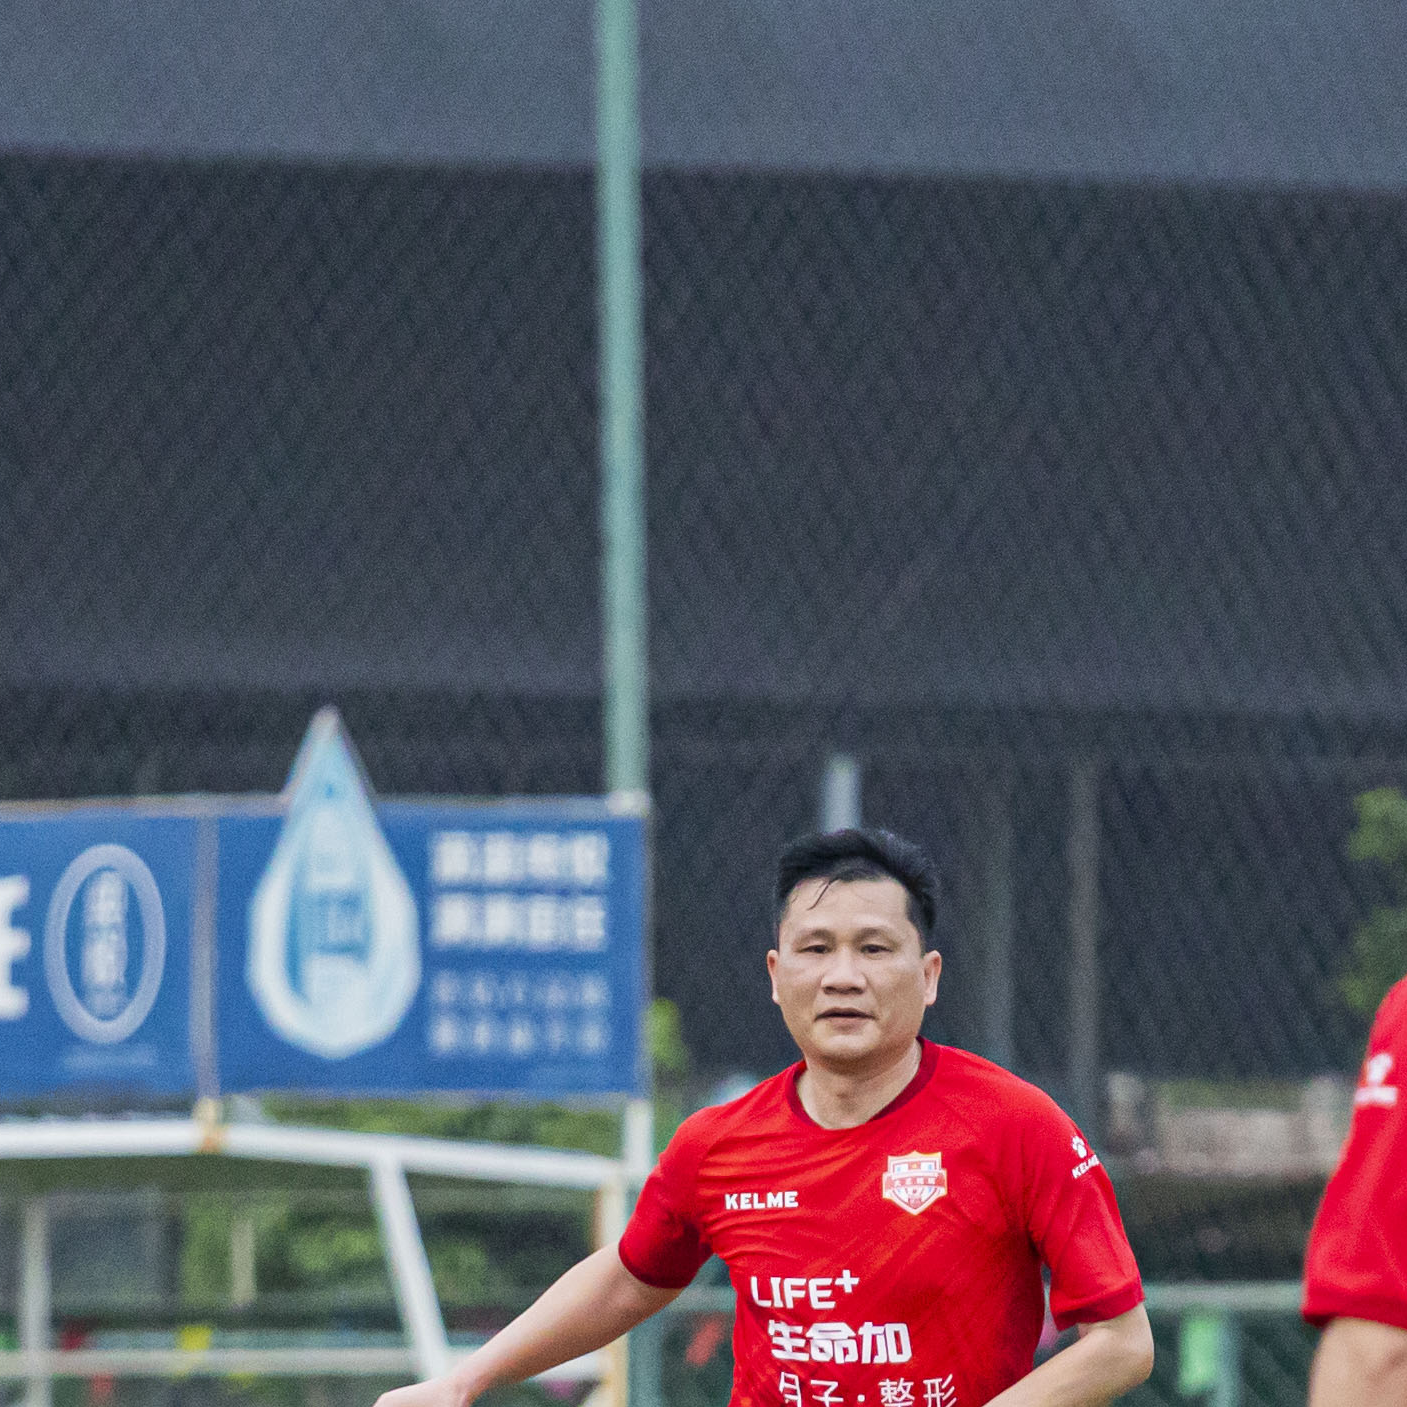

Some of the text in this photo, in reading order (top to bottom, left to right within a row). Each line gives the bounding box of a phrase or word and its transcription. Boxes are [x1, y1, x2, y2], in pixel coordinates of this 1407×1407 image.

[725, 1191, 798, 1210] KELME
[750, 1269, 859, 1309] LIFE+
[768, 1320, 912, 1364] 生命加
